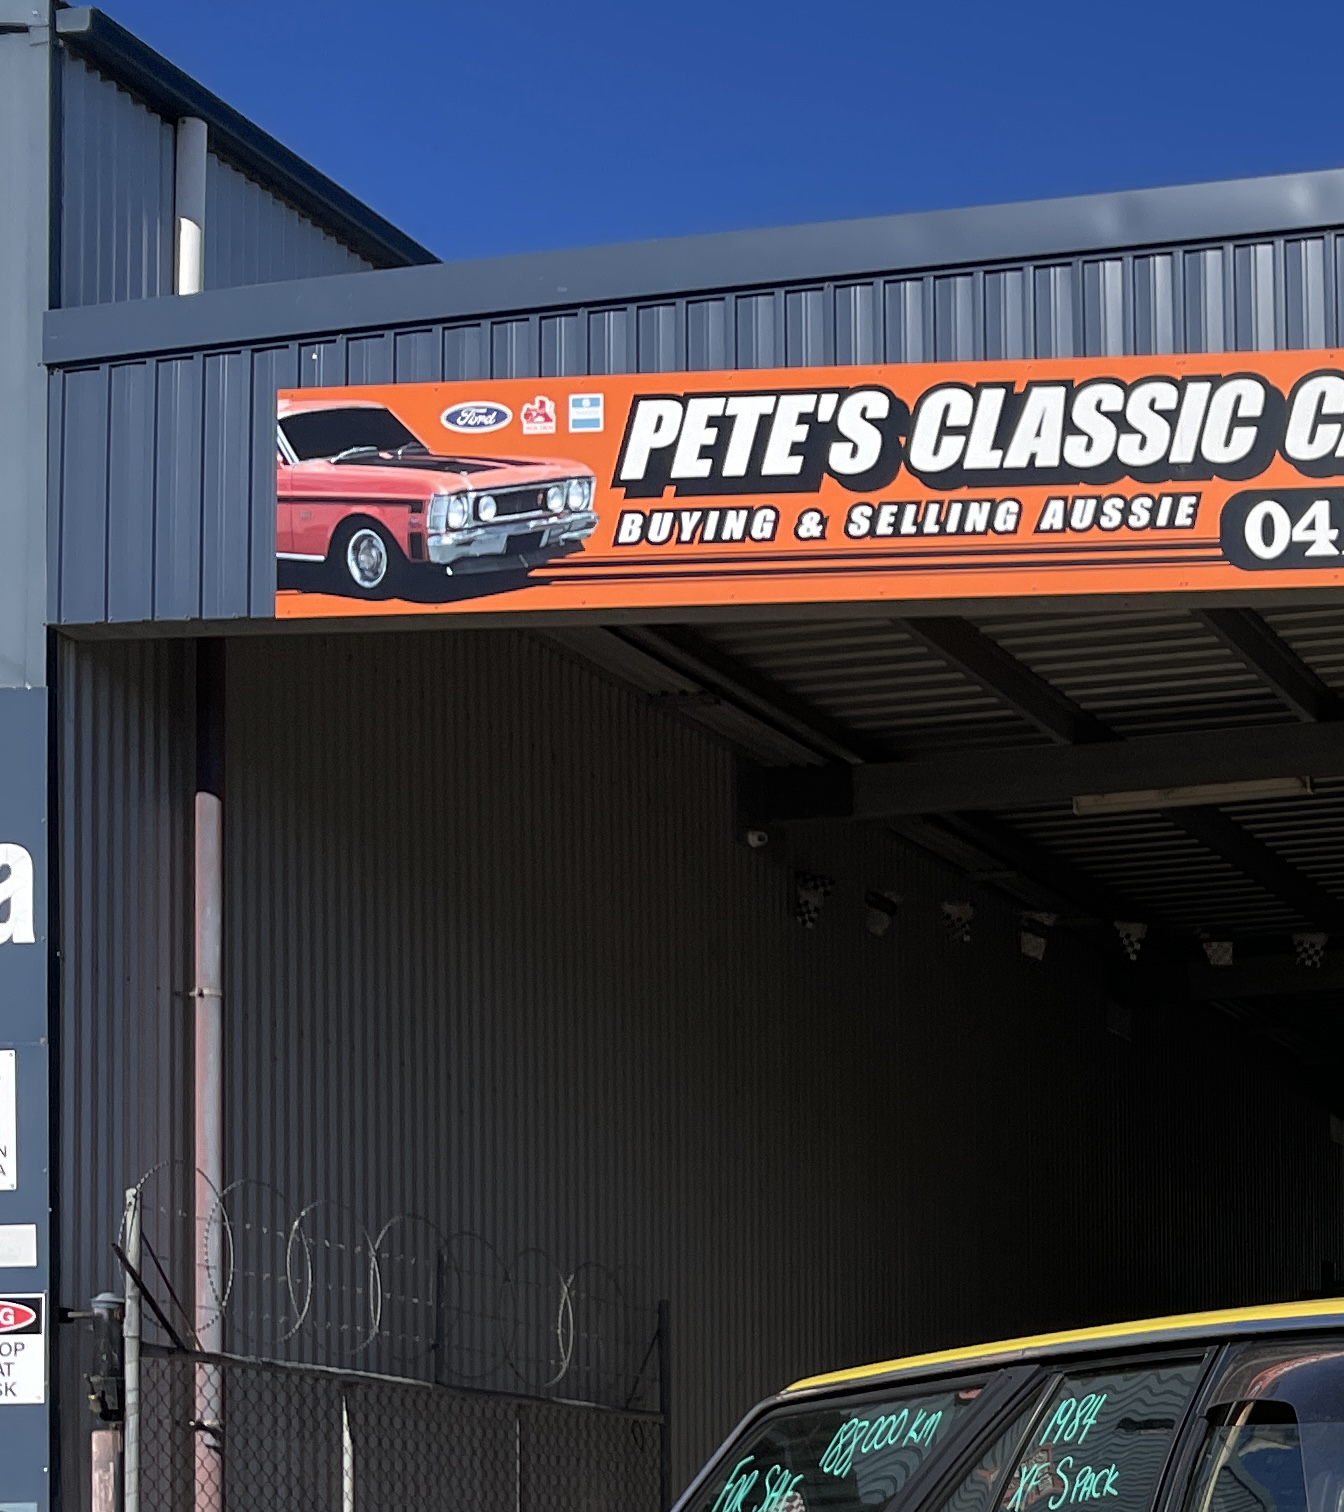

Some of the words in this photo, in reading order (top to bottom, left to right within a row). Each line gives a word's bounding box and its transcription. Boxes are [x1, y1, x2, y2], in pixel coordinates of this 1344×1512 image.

[456, 408, 497, 426] Ford
[620, 385, 890, 482] PETE'S
[908, 378, 1267, 473] CLASSIC
[618, 507, 775, 544] BUYING
[796, 510, 824, 540] &
[847, 501, 1018, 537] SELLING
[1039, 494, 1198, 532] AUSSIE
[1039, 1393, 1107, 1446] 1984
[1006, 1462, 1051, 1512] XF
